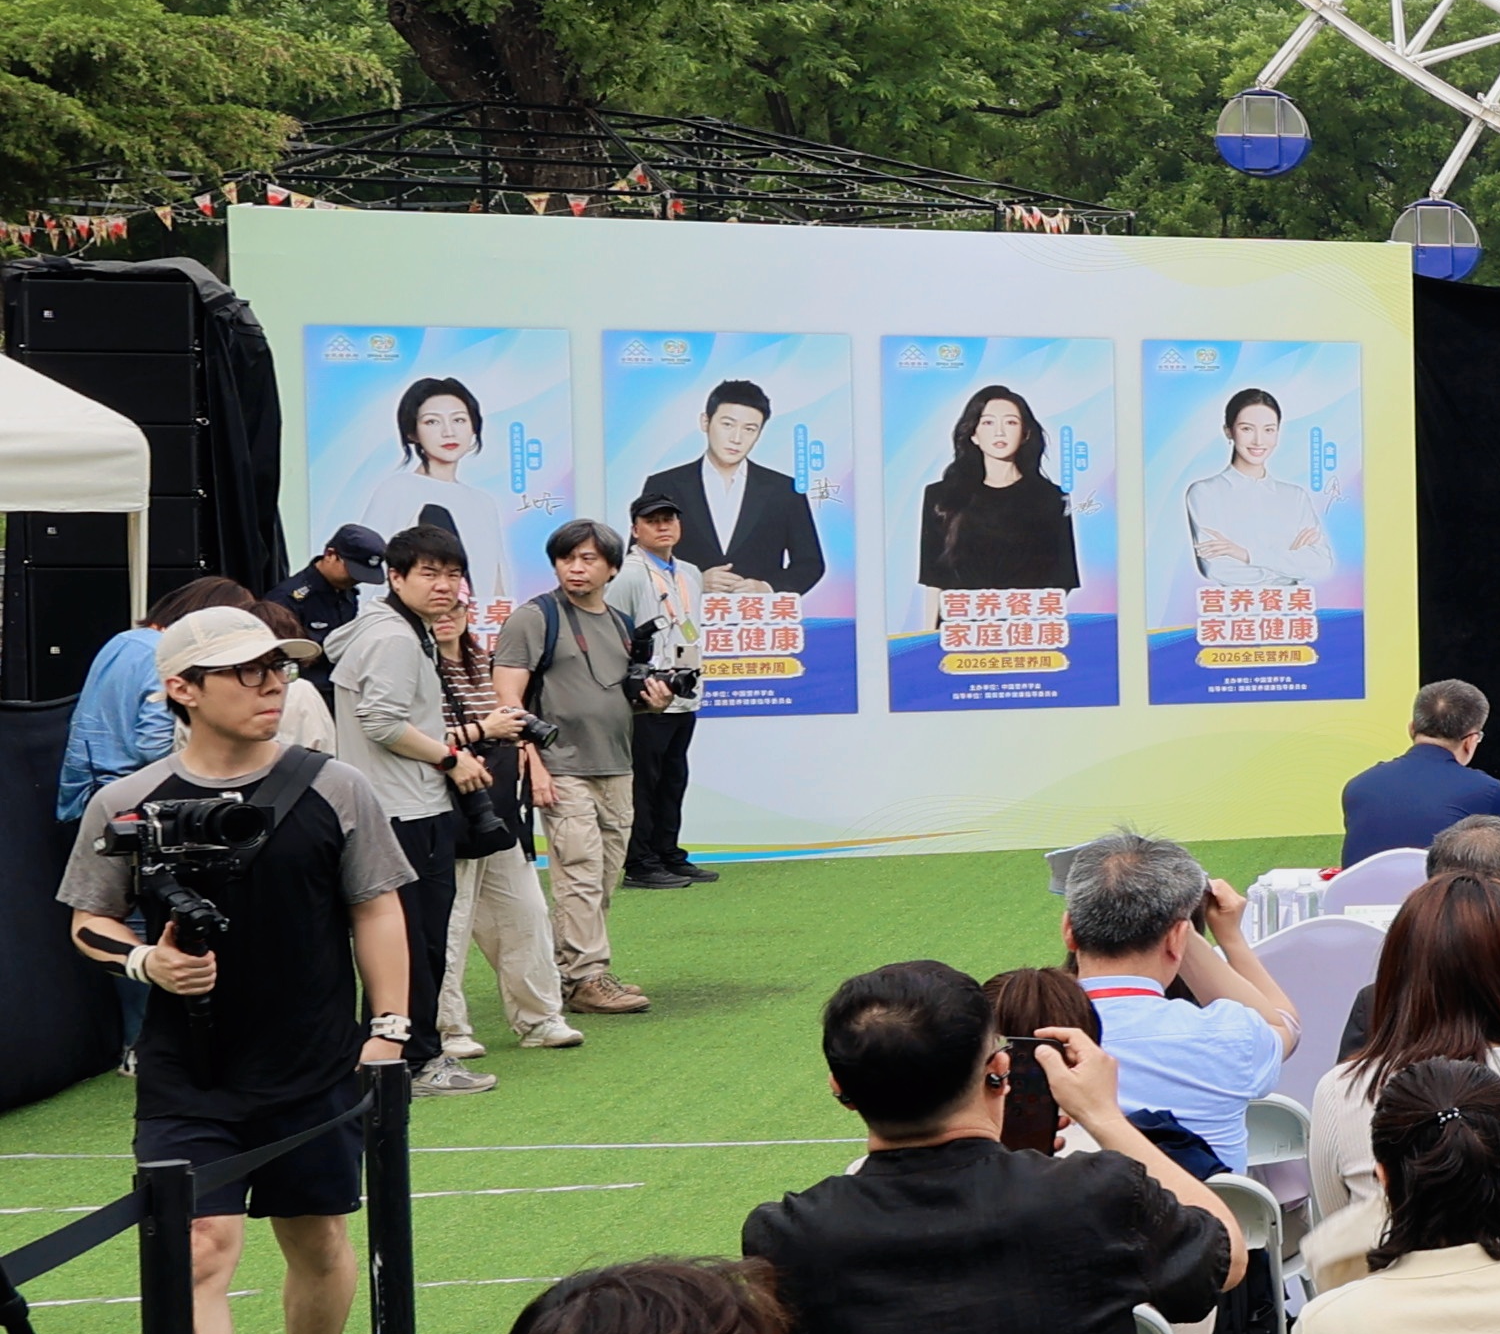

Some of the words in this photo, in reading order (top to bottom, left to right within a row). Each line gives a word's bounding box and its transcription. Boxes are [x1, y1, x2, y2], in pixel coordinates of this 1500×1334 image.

[703, 596, 798, 620] 养餐桌
[943, 592, 1064, 617] 营养餐桌
[1200, 588, 1313, 613] 营养餐桌
[704, 627, 799, 652] 庭健康
[944, 622, 1065, 647] 家庭健康
[1201, 617, 1313, 642] 家庭健康
[701, 662, 786, 675] 26全民营养周
[957, 656, 1051, 669] 2026全民营养周
[1212, 650, 1302, 663] 2026全民营养周
